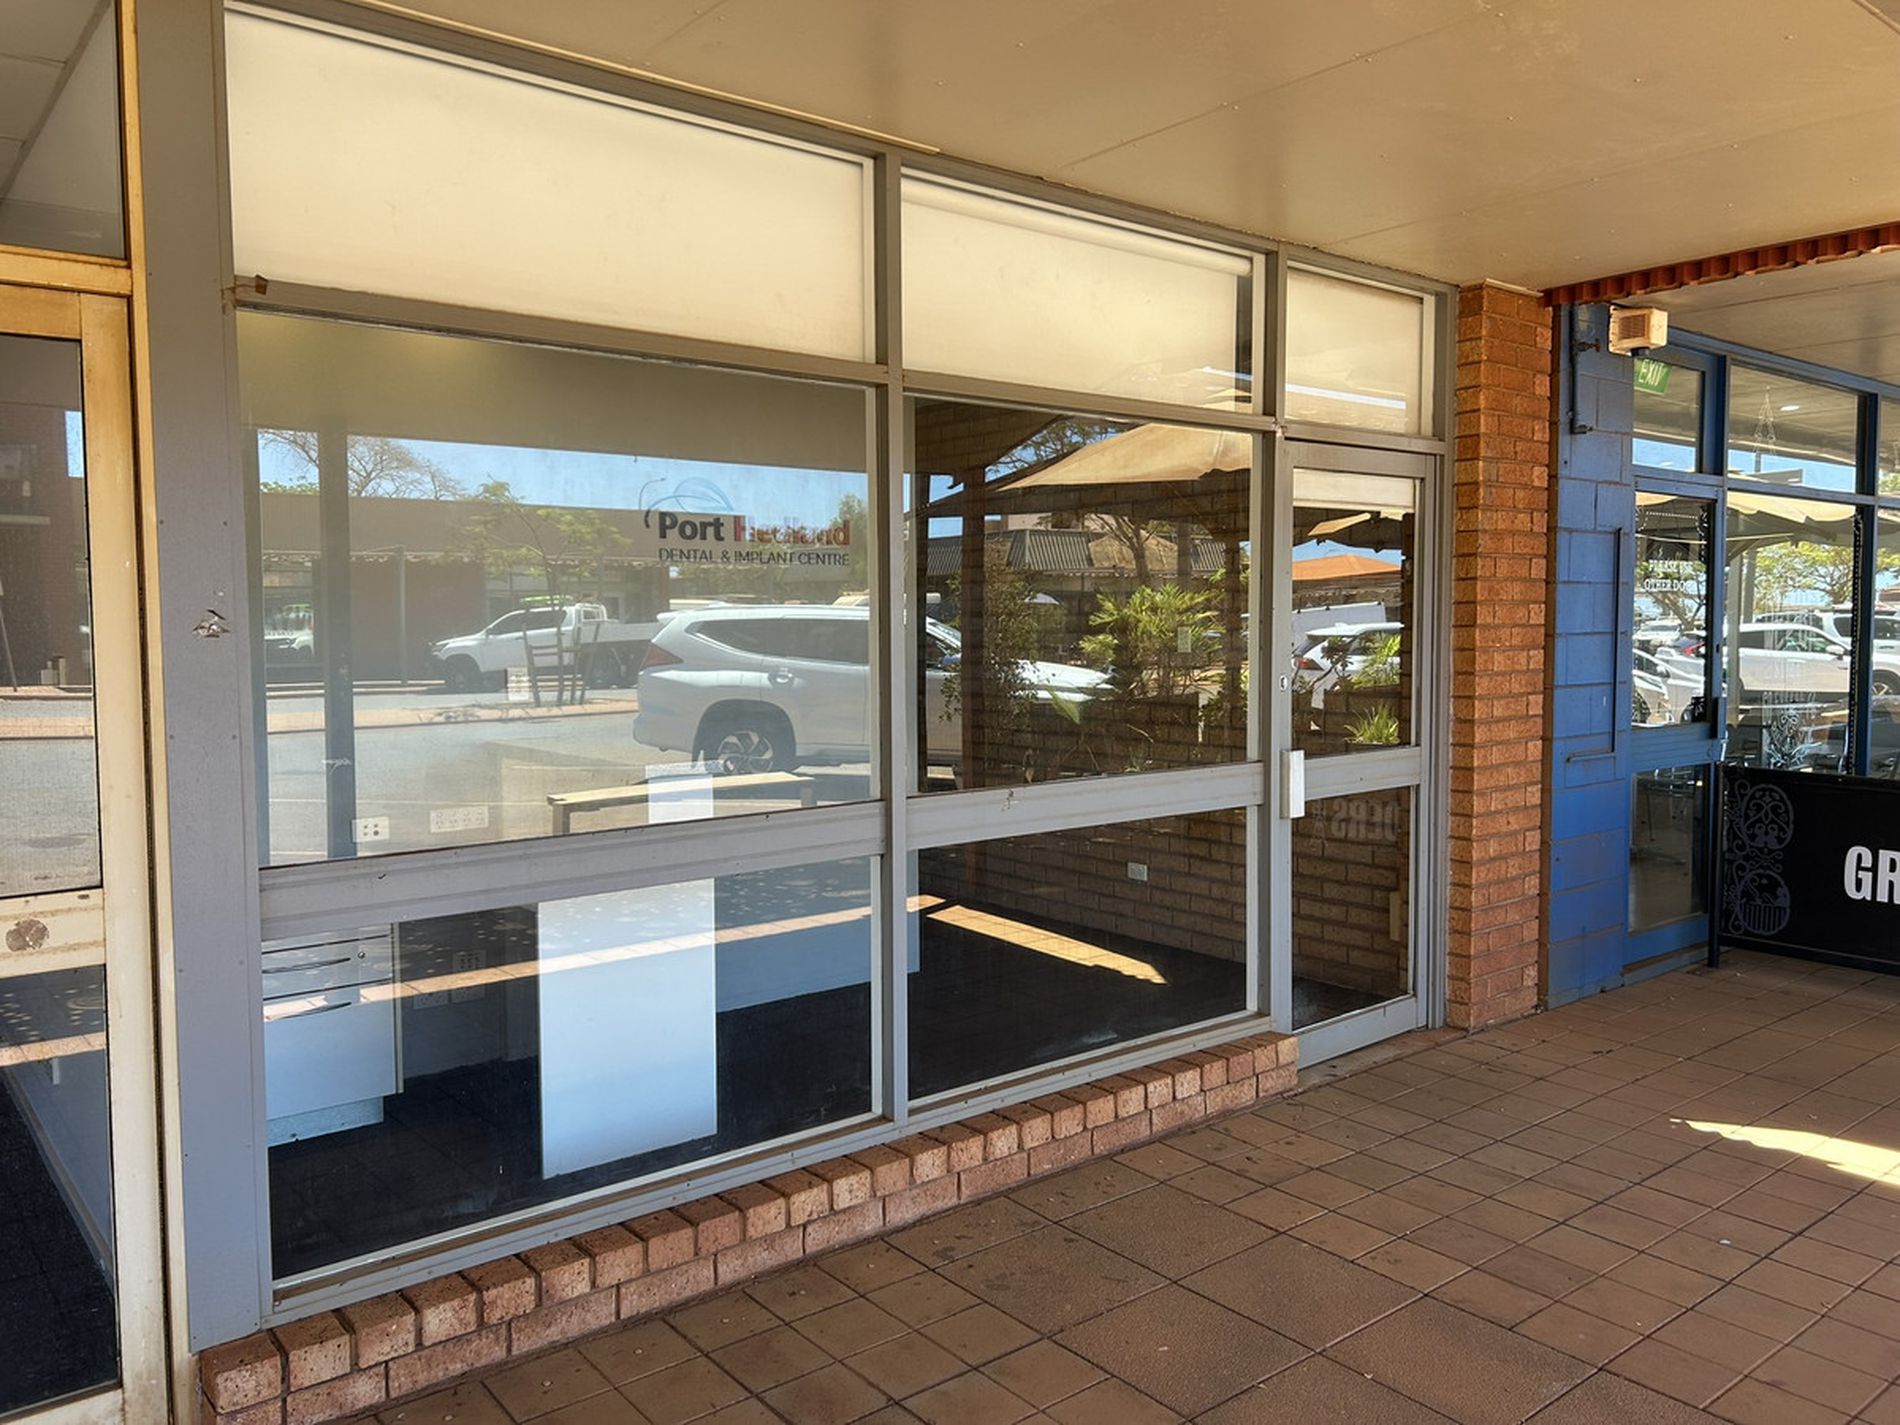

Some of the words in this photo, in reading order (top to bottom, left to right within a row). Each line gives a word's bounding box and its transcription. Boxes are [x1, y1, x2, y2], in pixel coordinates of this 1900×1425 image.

[1638, 359, 1666, 387] EXIT
[658, 511, 725, 542] Port
[658, 547, 714, 562] DENTAL
[720, 549, 731, 562] &
[734, 550, 795, 565] IMPLANT
[798, 552, 850, 566] CENTRE
